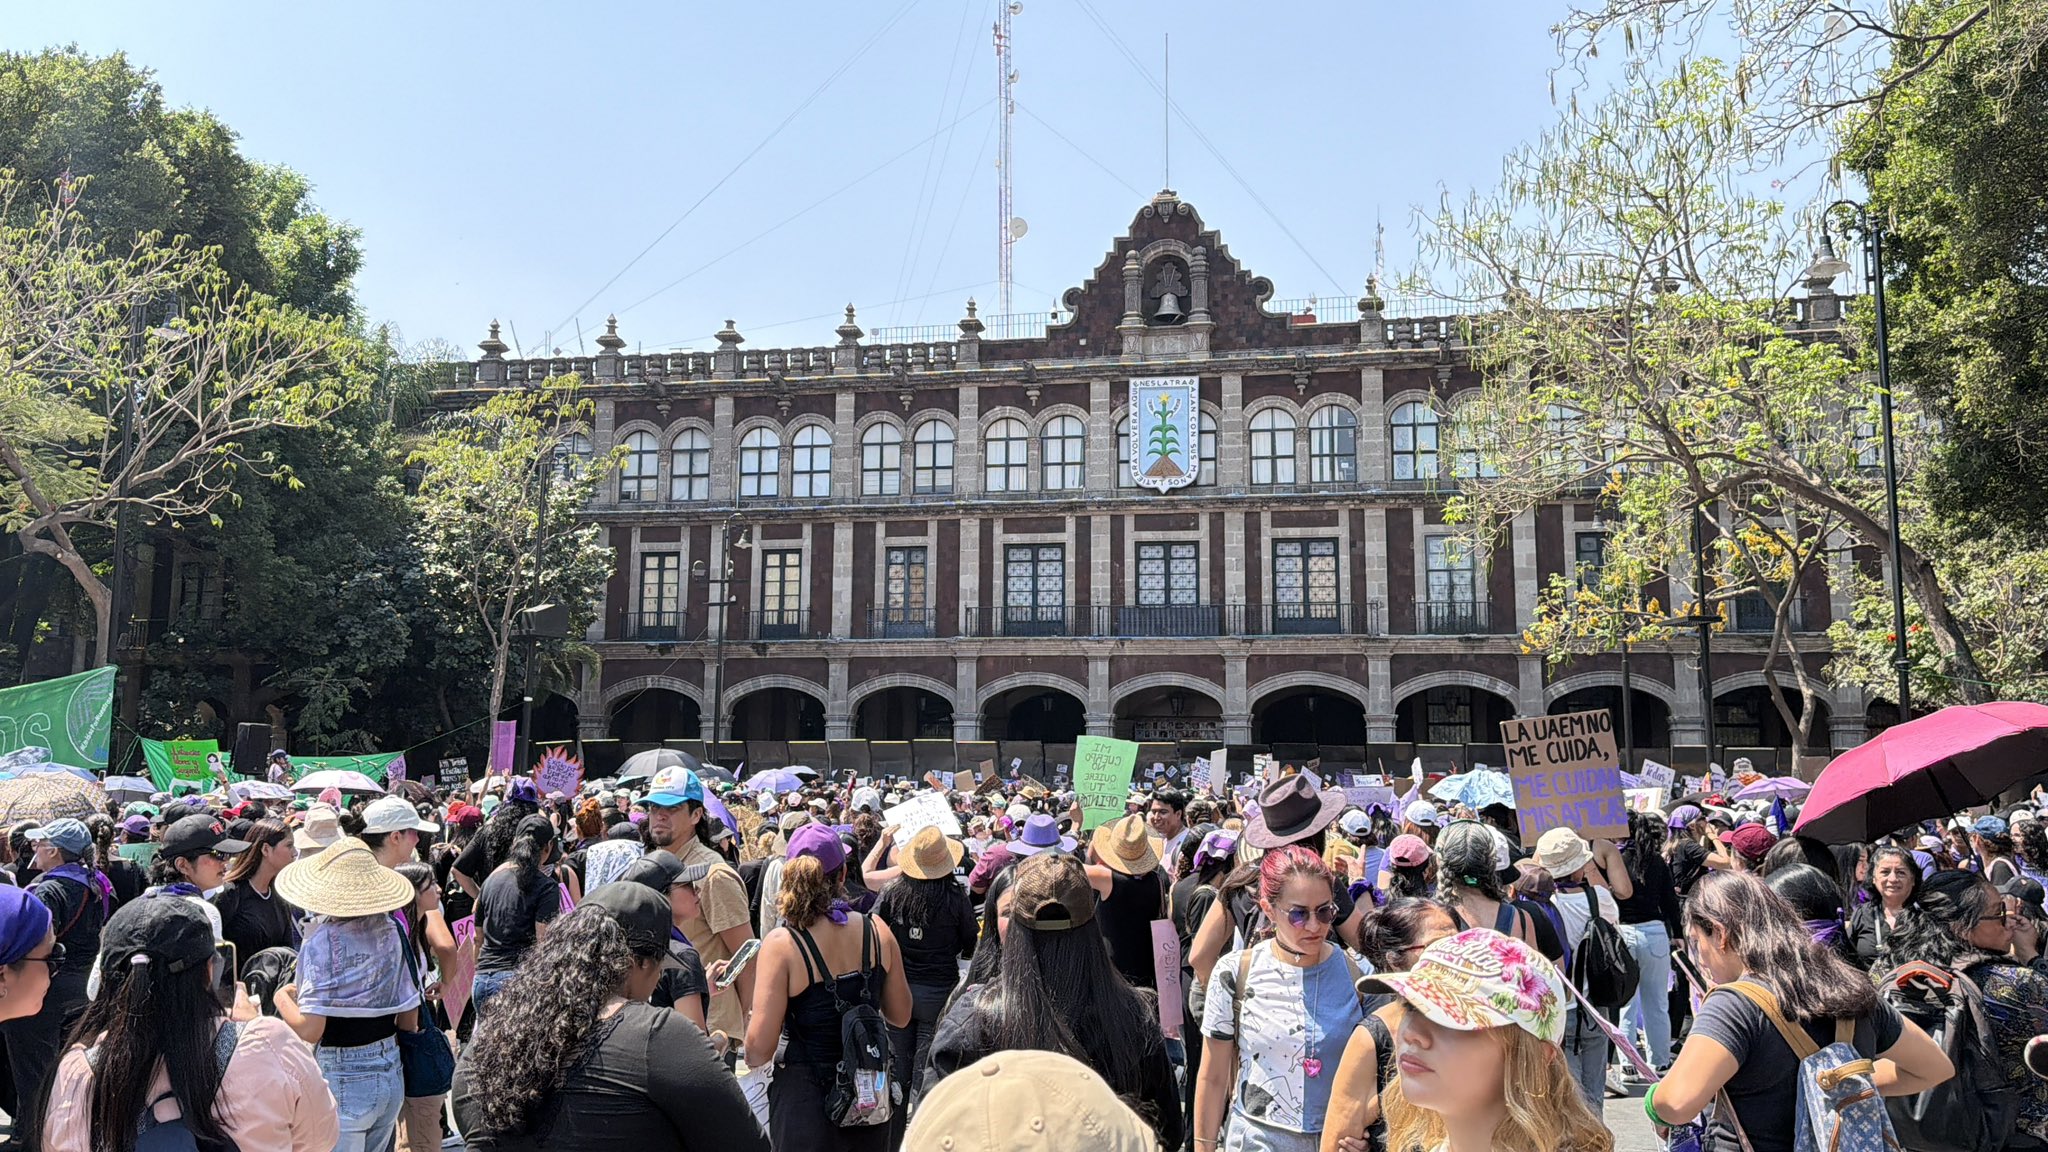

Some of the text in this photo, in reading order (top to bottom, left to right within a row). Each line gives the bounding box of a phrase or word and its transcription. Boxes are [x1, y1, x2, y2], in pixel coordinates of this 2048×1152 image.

[1503, 712, 1611, 744] LA UAEM NO
[1508, 737, 1610, 768] ME CUIDA,
[1513, 773, 1551, 800] ME
[1551, 764, 1620, 797] CUIDAN
[1520, 804, 1559, 834] MIS
